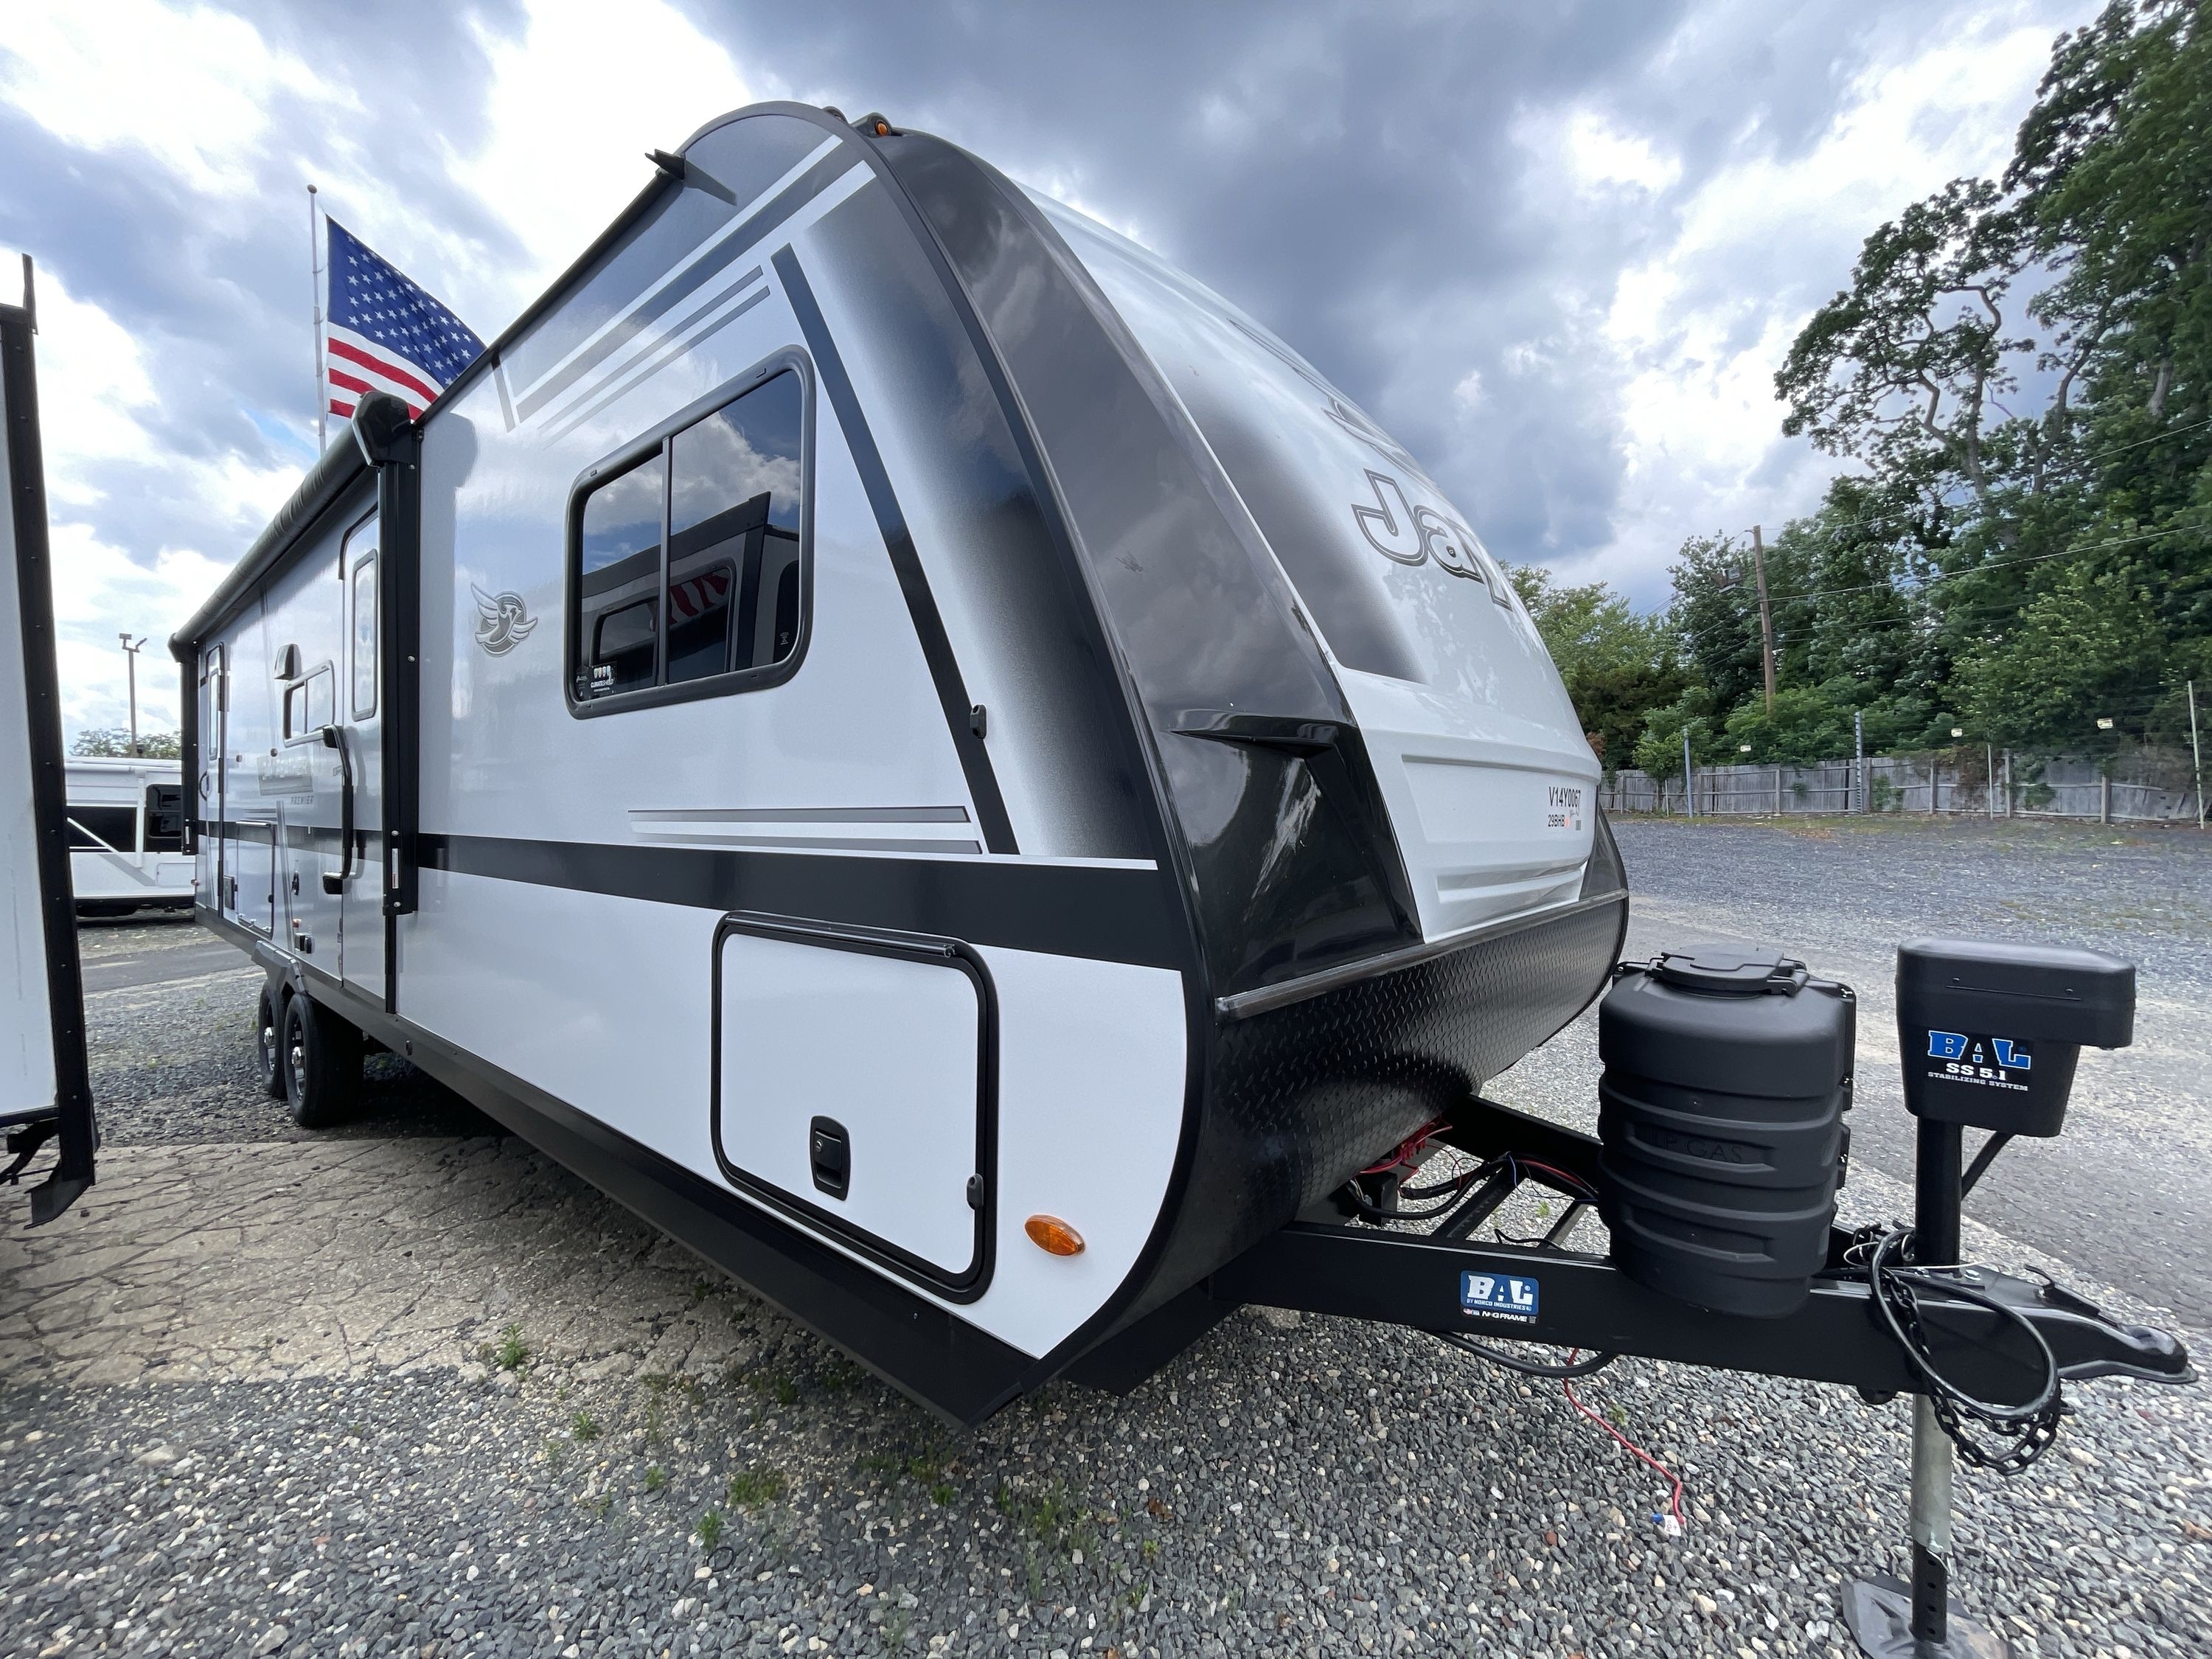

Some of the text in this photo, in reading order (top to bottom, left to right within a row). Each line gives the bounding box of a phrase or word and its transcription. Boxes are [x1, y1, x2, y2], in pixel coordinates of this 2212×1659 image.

[1549, 786, 1581, 807] V14Y0067
[1548, 814, 1565, 827] 29BHB
[1927, 1030, 2031, 1069] BAL
[1946, 1062, 1974, 1075] SS
[1927, 1071, 2028, 1091] STABILIZING SYSTEM
[1687, 1138, 1743, 1163] GAS
[1467, 1275, 1534, 1305] BAL
[1494, 1301, 1526, 1311] INDUSTRIES
[1500, 1313, 1528, 1322] FRAME
